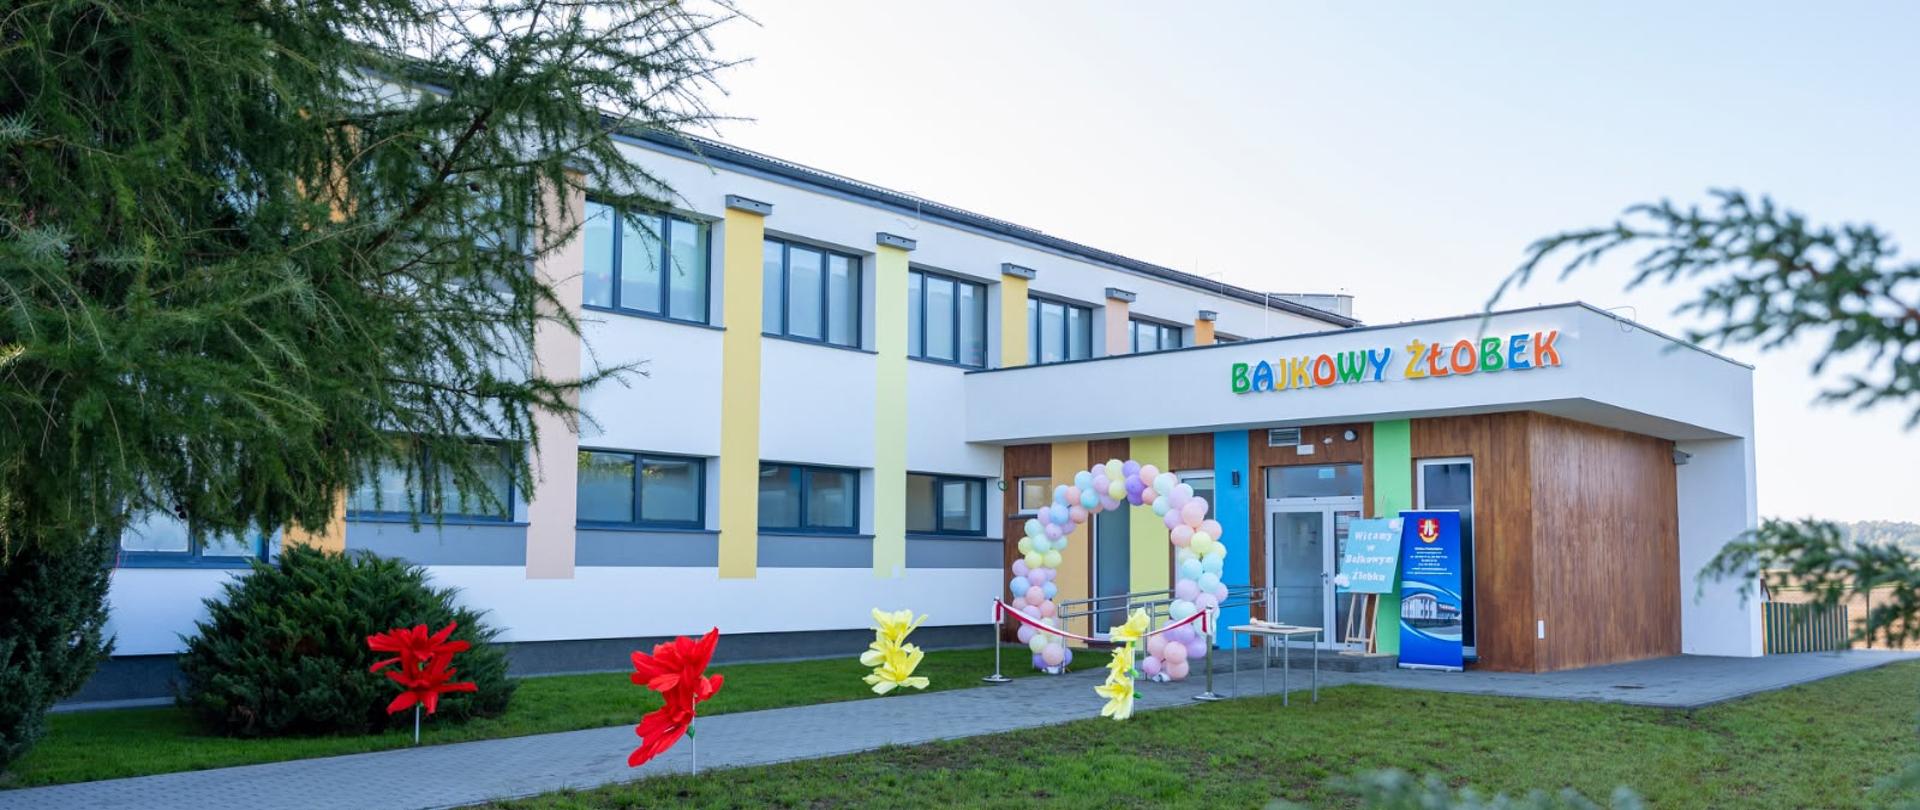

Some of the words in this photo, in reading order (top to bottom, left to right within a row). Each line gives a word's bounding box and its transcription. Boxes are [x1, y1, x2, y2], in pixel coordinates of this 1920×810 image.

[1231, 347, 1392, 394] BAJKOWY
[1404, 329, 1562, 380] ŻŁOBEK
[1355, 531, 1393, 542] Witamy
